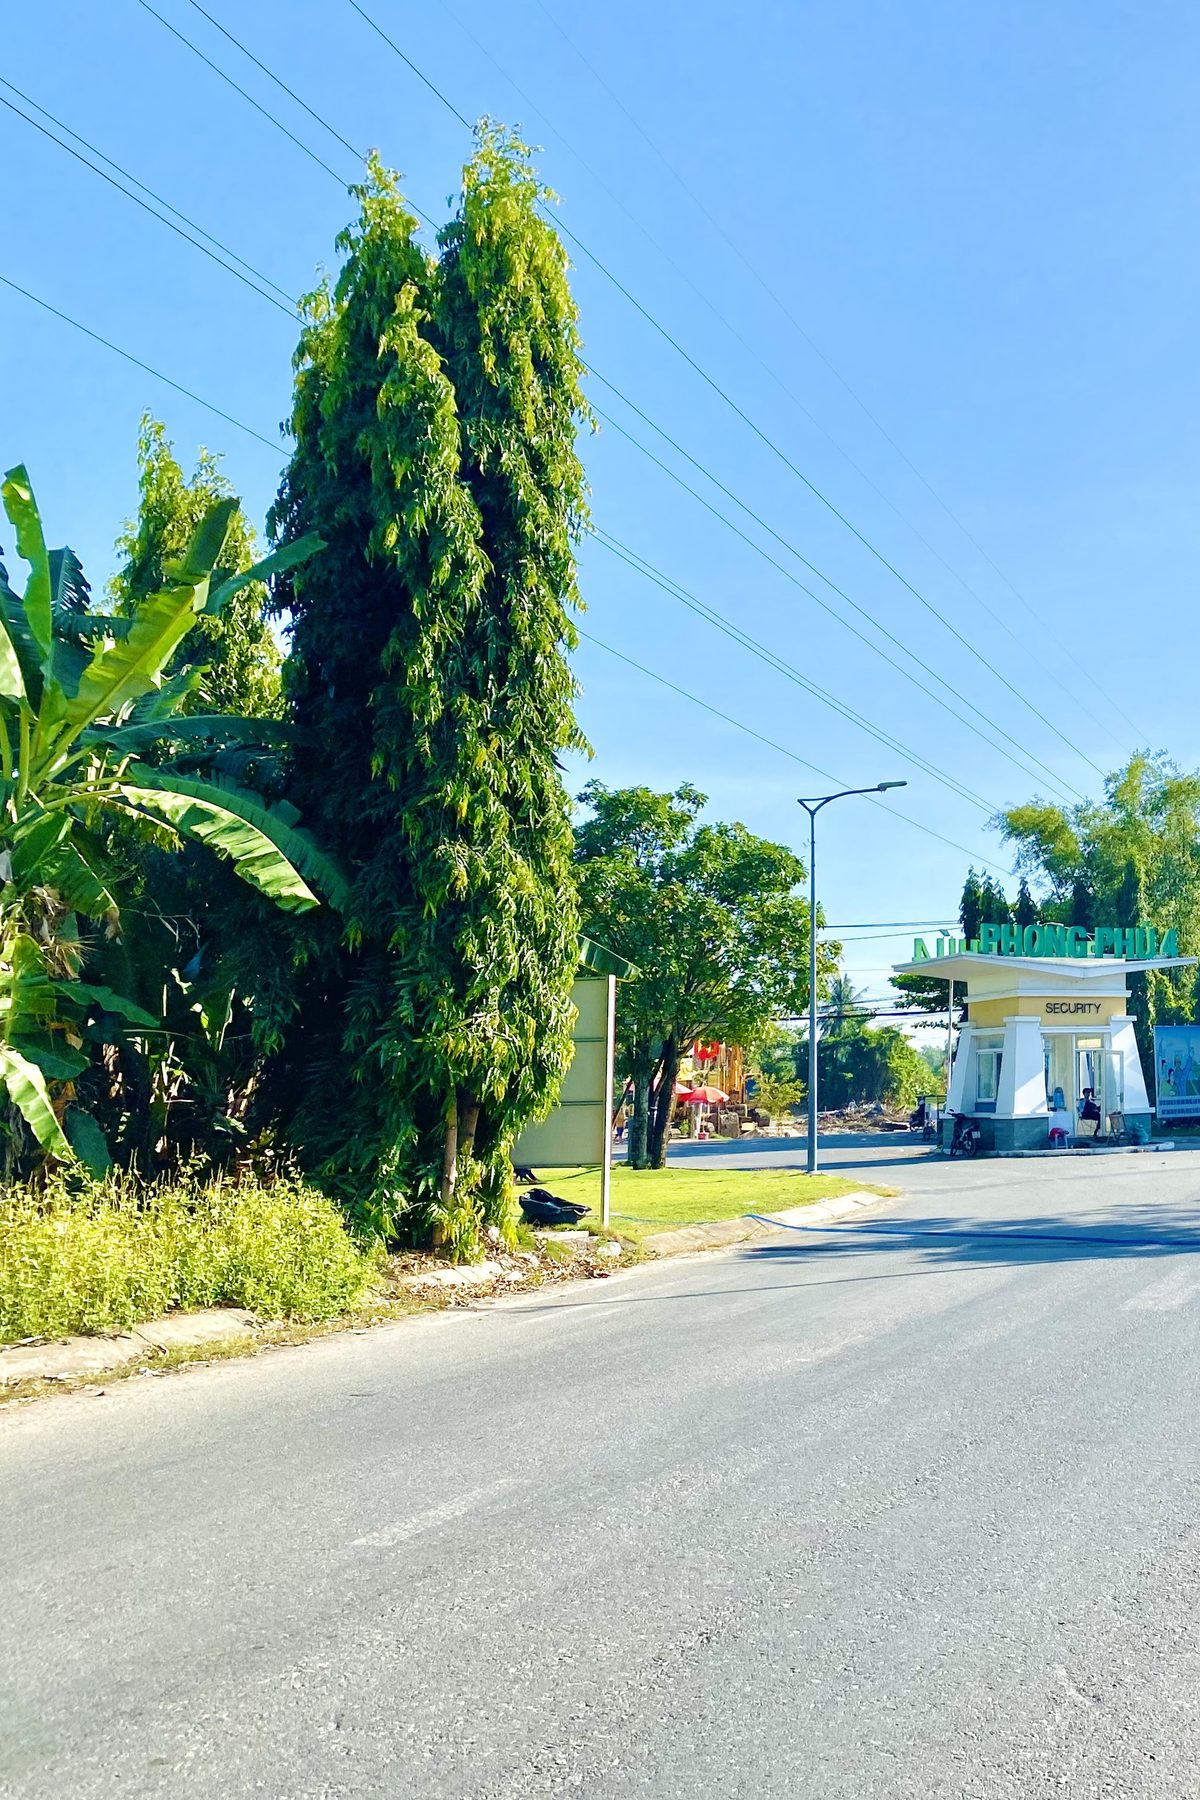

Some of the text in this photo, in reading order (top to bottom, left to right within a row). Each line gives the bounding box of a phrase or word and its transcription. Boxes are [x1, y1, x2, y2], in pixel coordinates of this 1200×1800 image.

[980, 923, 1088, 958] PHONG
[1159, 928, 1178, 958] 4
[1045, 1002, 1102, 1014] SECURITY
